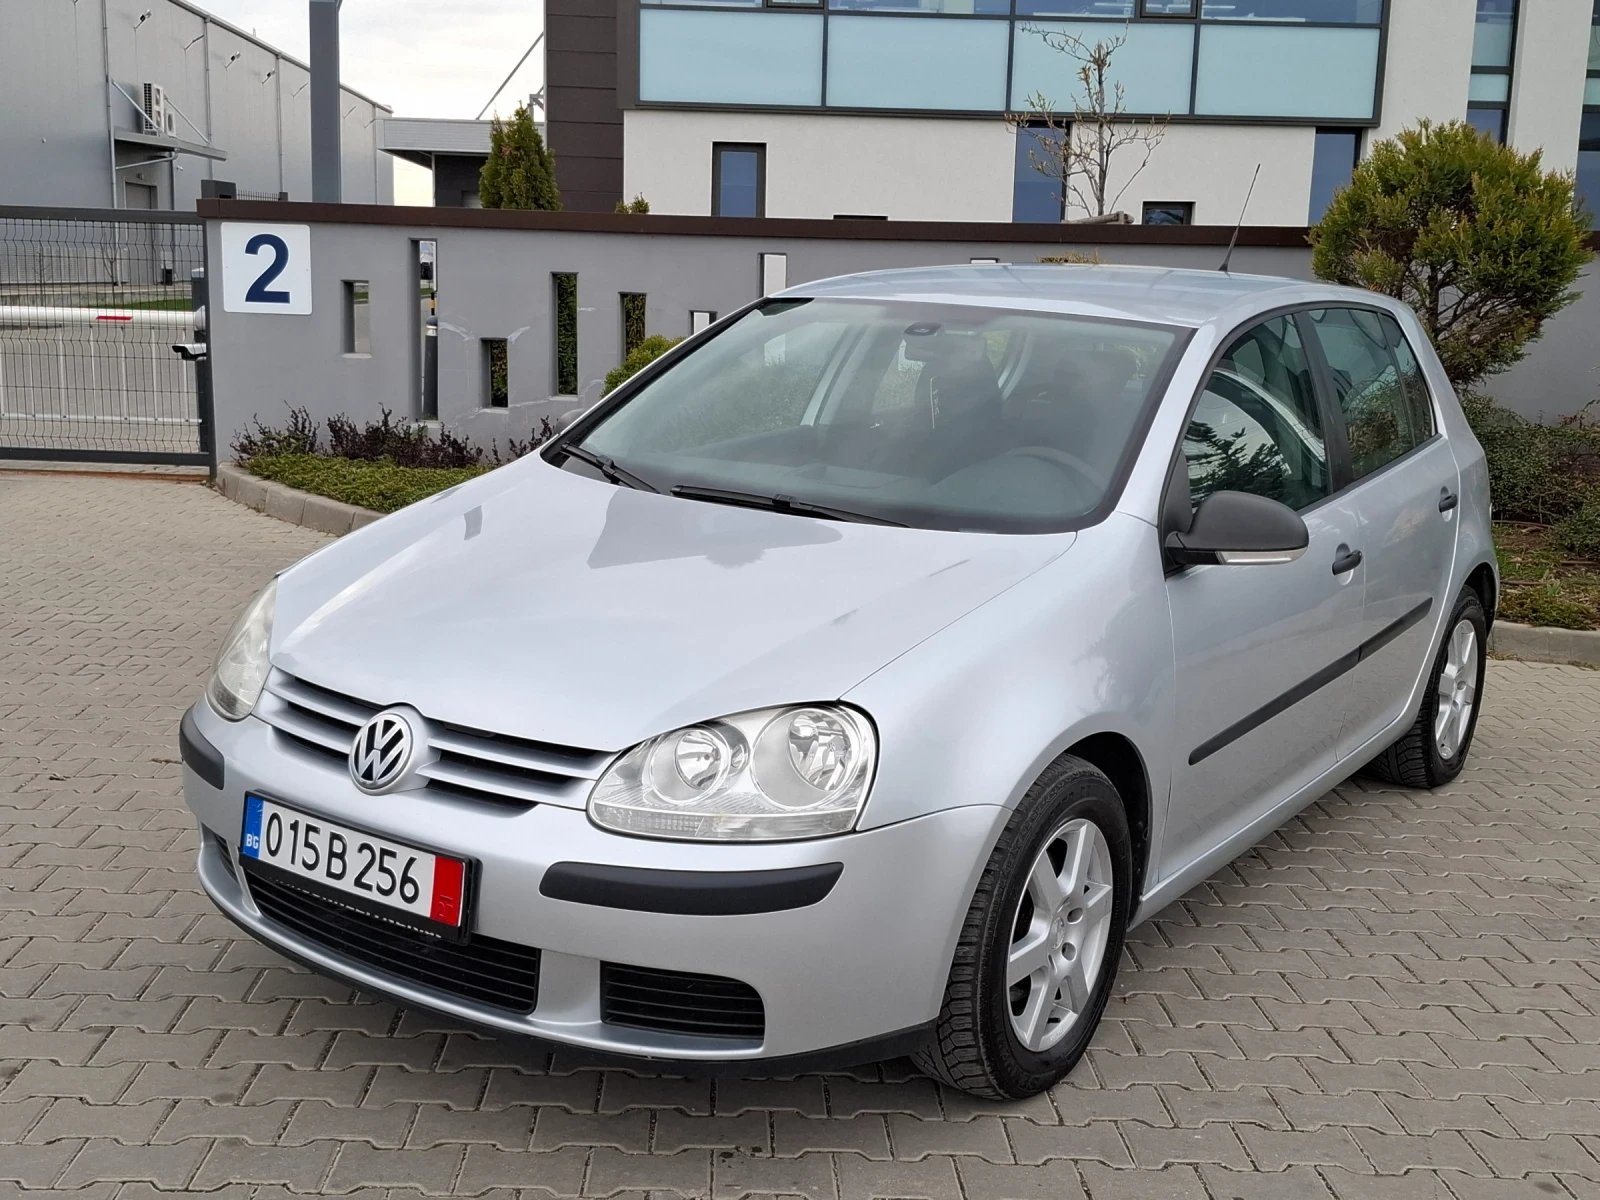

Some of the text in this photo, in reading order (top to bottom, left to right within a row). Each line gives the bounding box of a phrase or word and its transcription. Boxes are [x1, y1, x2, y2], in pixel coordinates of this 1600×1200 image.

[245, 233, 290, 303] 2
[352, 714, 409, 784] VW
[246, 833, 259, 849] BG
